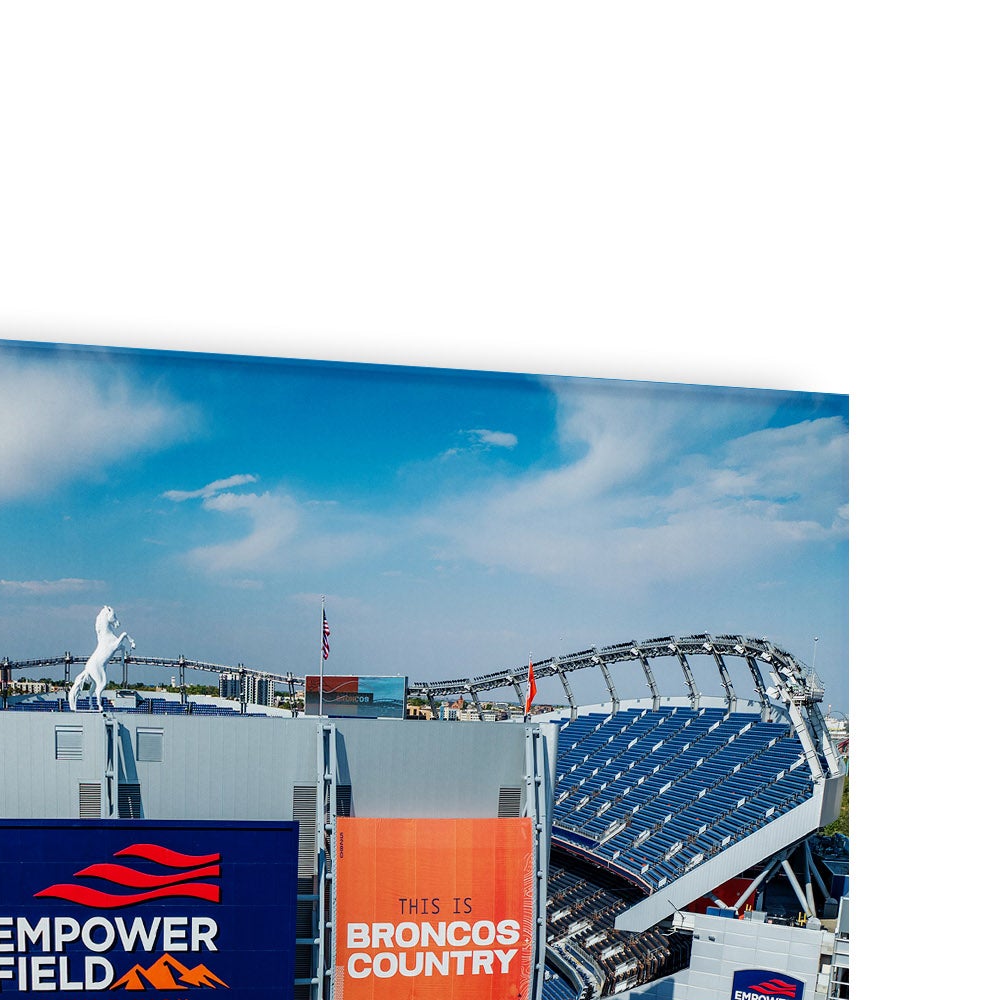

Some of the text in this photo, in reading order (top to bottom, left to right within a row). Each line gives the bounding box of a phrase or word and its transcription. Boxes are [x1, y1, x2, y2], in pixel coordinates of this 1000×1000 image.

[399, 897, 473, 915] THIS IS
[346, 919, 520, 949] BRONCOS
[347, 949, 518, 979] COUNTRY
